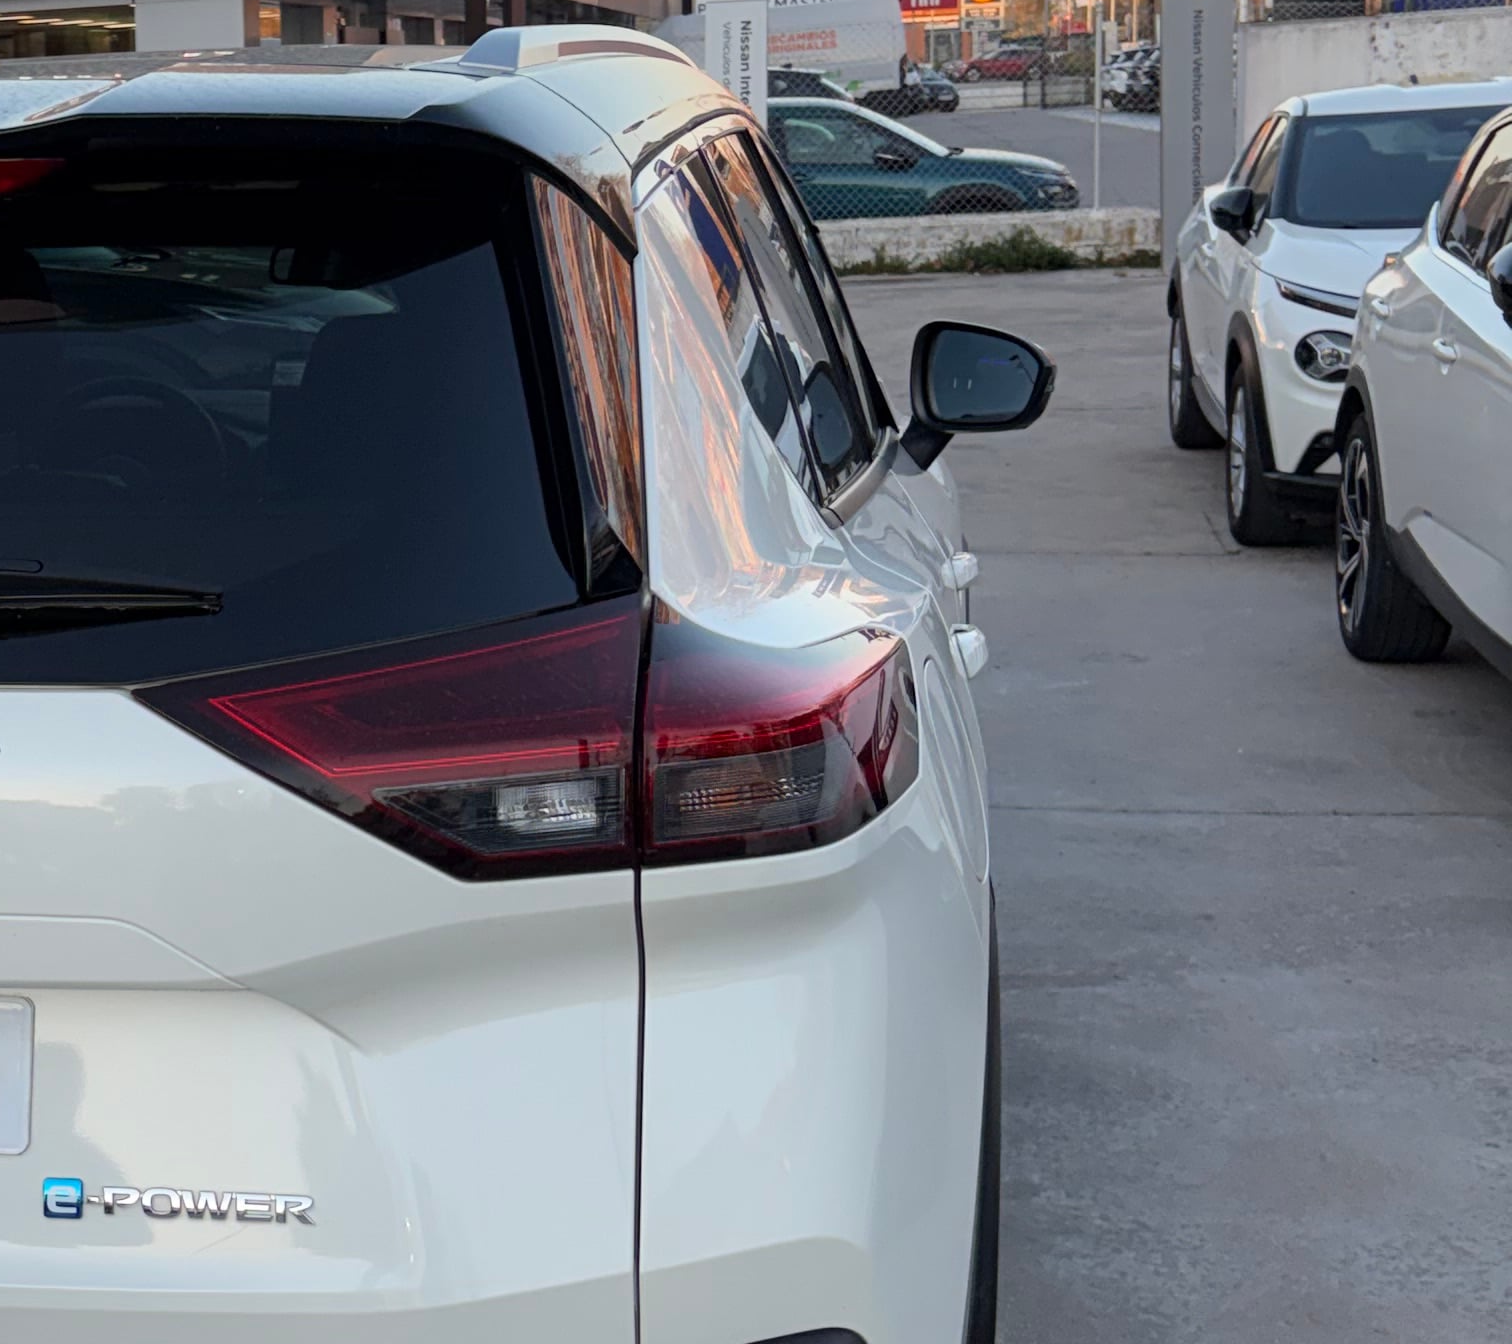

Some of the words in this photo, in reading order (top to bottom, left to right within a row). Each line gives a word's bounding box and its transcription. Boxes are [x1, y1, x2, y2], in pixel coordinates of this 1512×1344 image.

[740, 20, 752, 72] Nissan
[1192, 9, 1204, 55] Nissan
[44, 1178, 316, 1225] e-POWER
